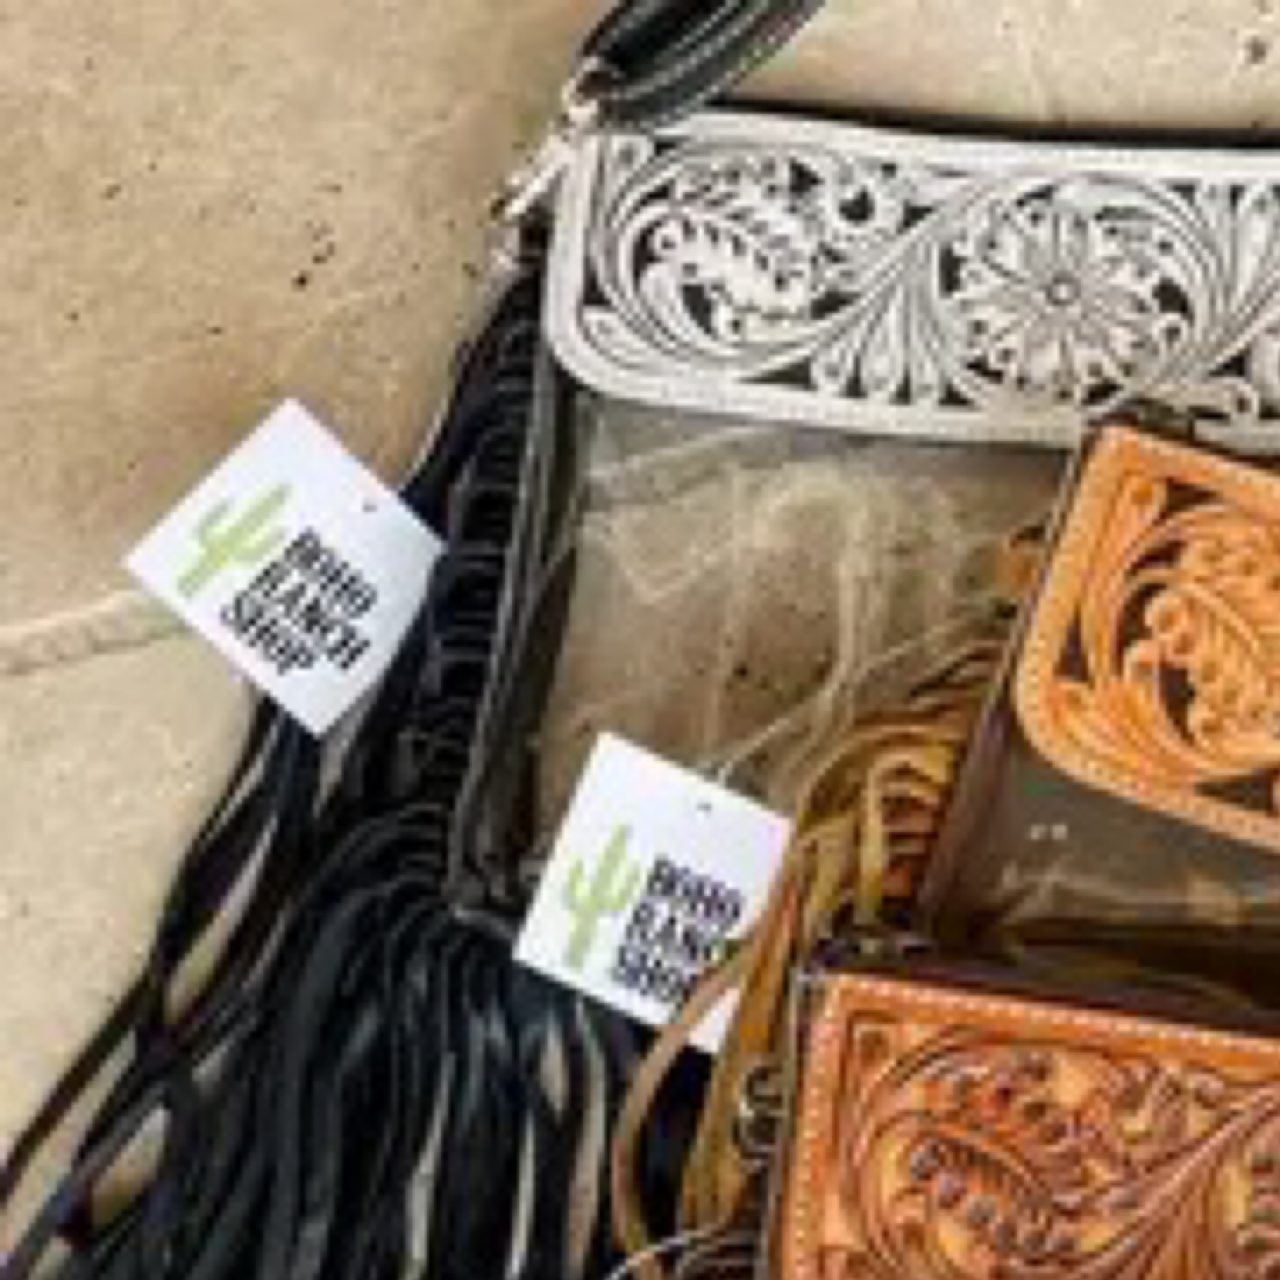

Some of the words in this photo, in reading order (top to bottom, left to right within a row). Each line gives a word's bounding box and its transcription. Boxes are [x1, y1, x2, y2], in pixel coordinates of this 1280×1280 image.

[221, 591, 315, 675] SHOP
[249, 558, 372, 671] RANCH
[609, 945, 699, 1003] SHO
